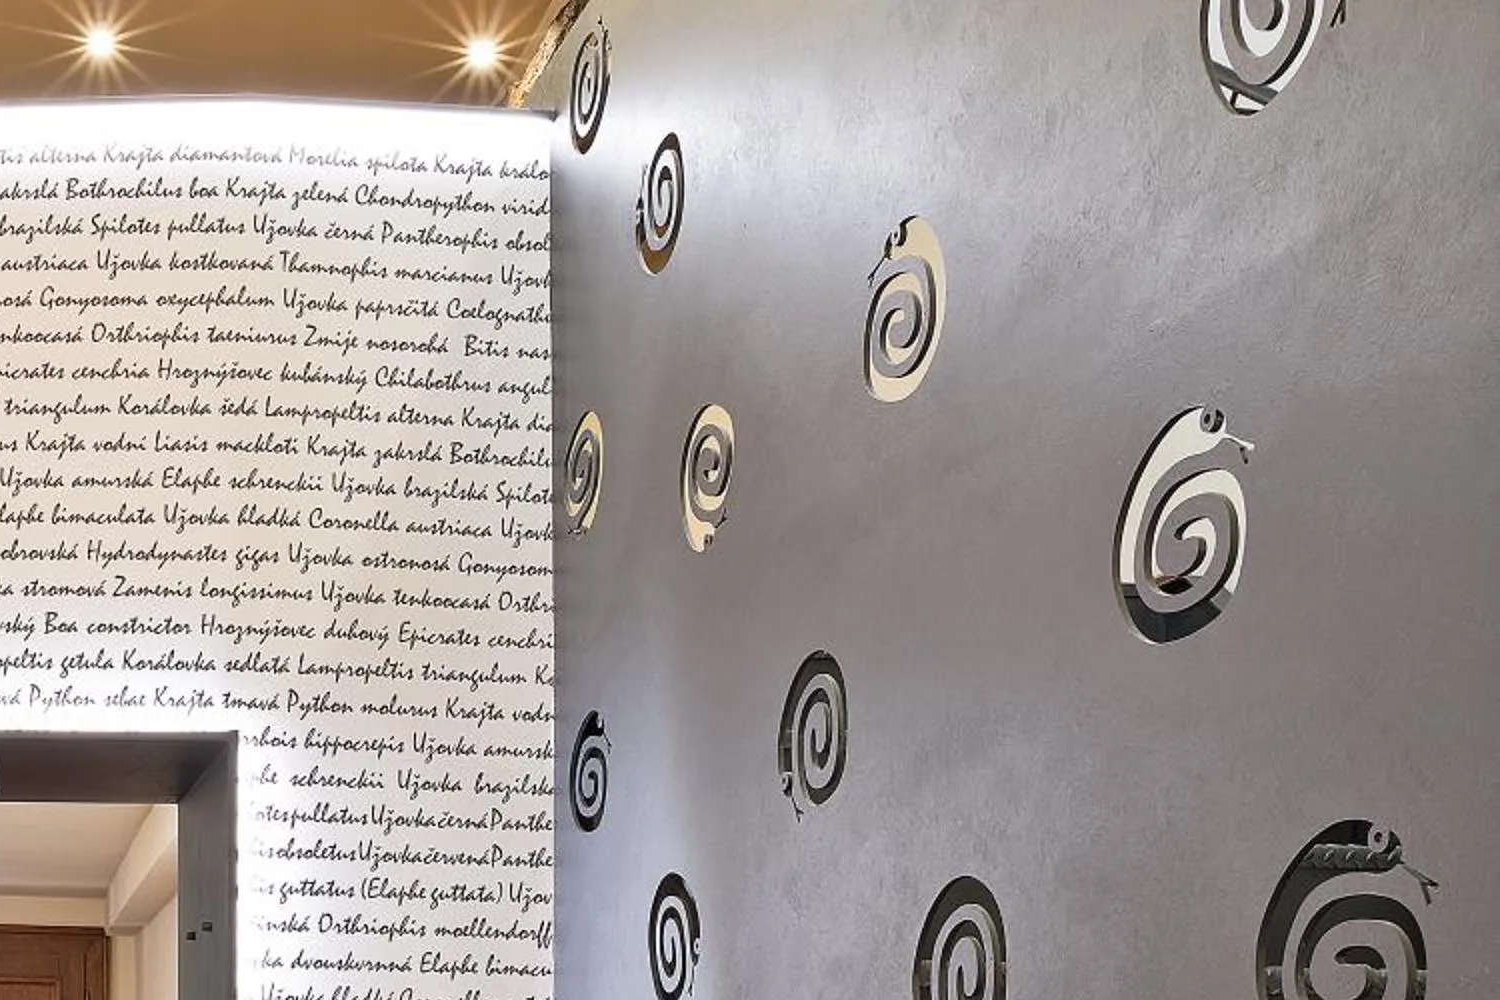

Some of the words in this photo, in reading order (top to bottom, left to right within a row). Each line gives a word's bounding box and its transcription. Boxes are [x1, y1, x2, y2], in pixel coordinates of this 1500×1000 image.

[66, 177, 182, 200] Bothrochilus
[189, 176, 219, 198] boa
[226, 176, 286, 207] Krajta
[355, 184, 495, 218] Chondropython
[40, 286, 148, 316] Gonyosoma
[4, 394, 111, 424] triangulum
[265, 396, 381, 428] Lampropeltis
[387, 403, 455, 426] alterna
[462, 406, 521, 438] Krajta
[51, 502, 156, 525] bimaculata
[308, 508, 400, 532] Coronella
[406, 518, 492, 539] austriaca
[44, 612, 78, 634] Boa
[87, 616, 192, 634] constrictor
[398, 620, 481, 650] Epicrates
